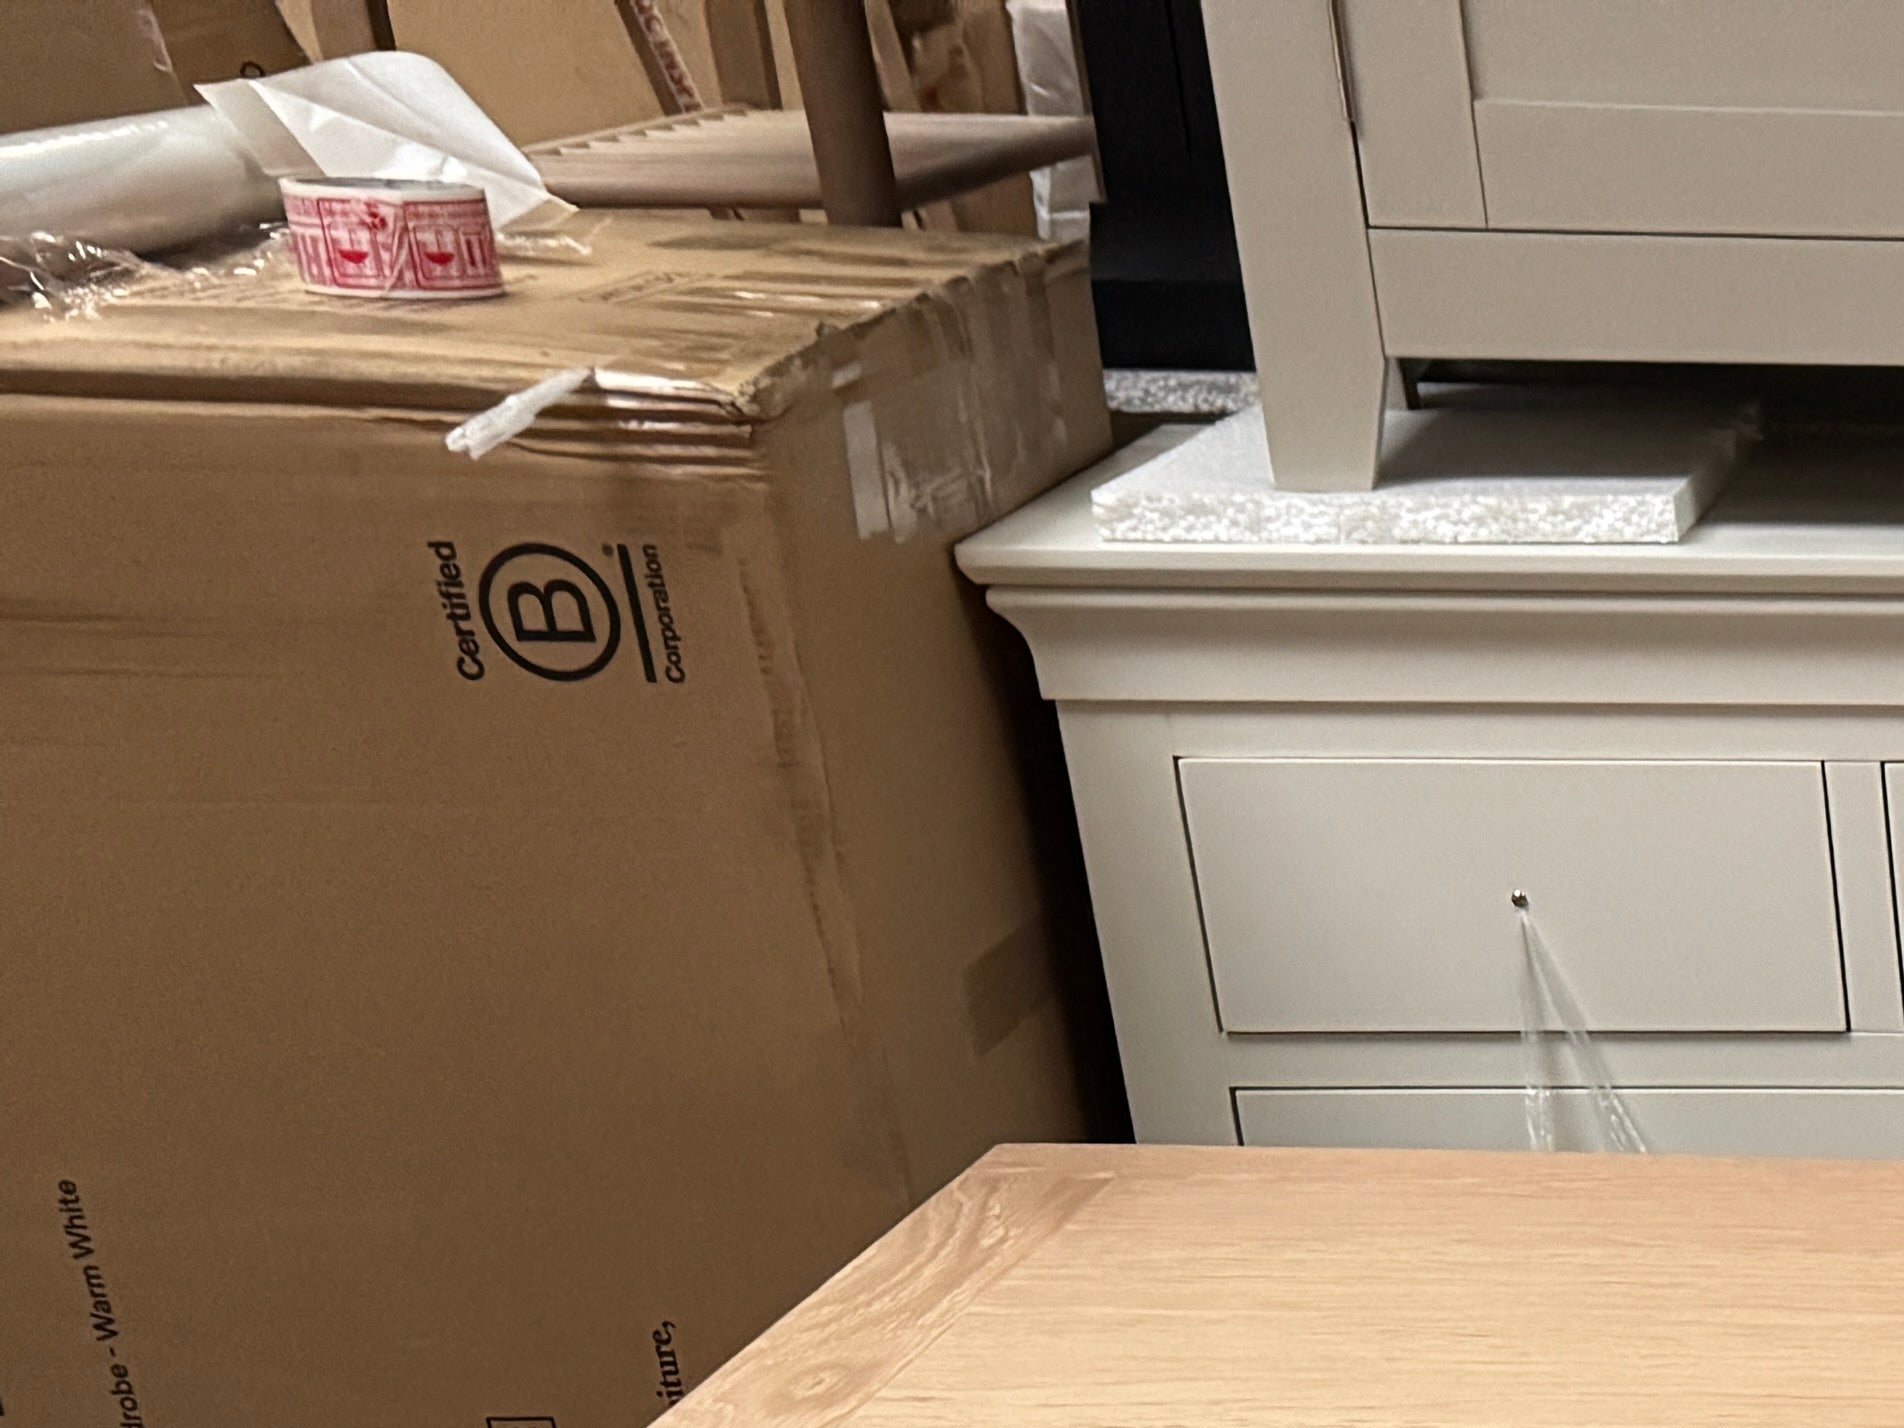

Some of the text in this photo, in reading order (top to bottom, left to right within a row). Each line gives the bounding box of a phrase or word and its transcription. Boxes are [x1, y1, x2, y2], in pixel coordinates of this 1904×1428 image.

[427, 540, 485, 681] Certified
[642, 543, 686, 684] Corporation
[58, 1179, 95, 1260] White
[83, 1265, 119, 1343] Warm
